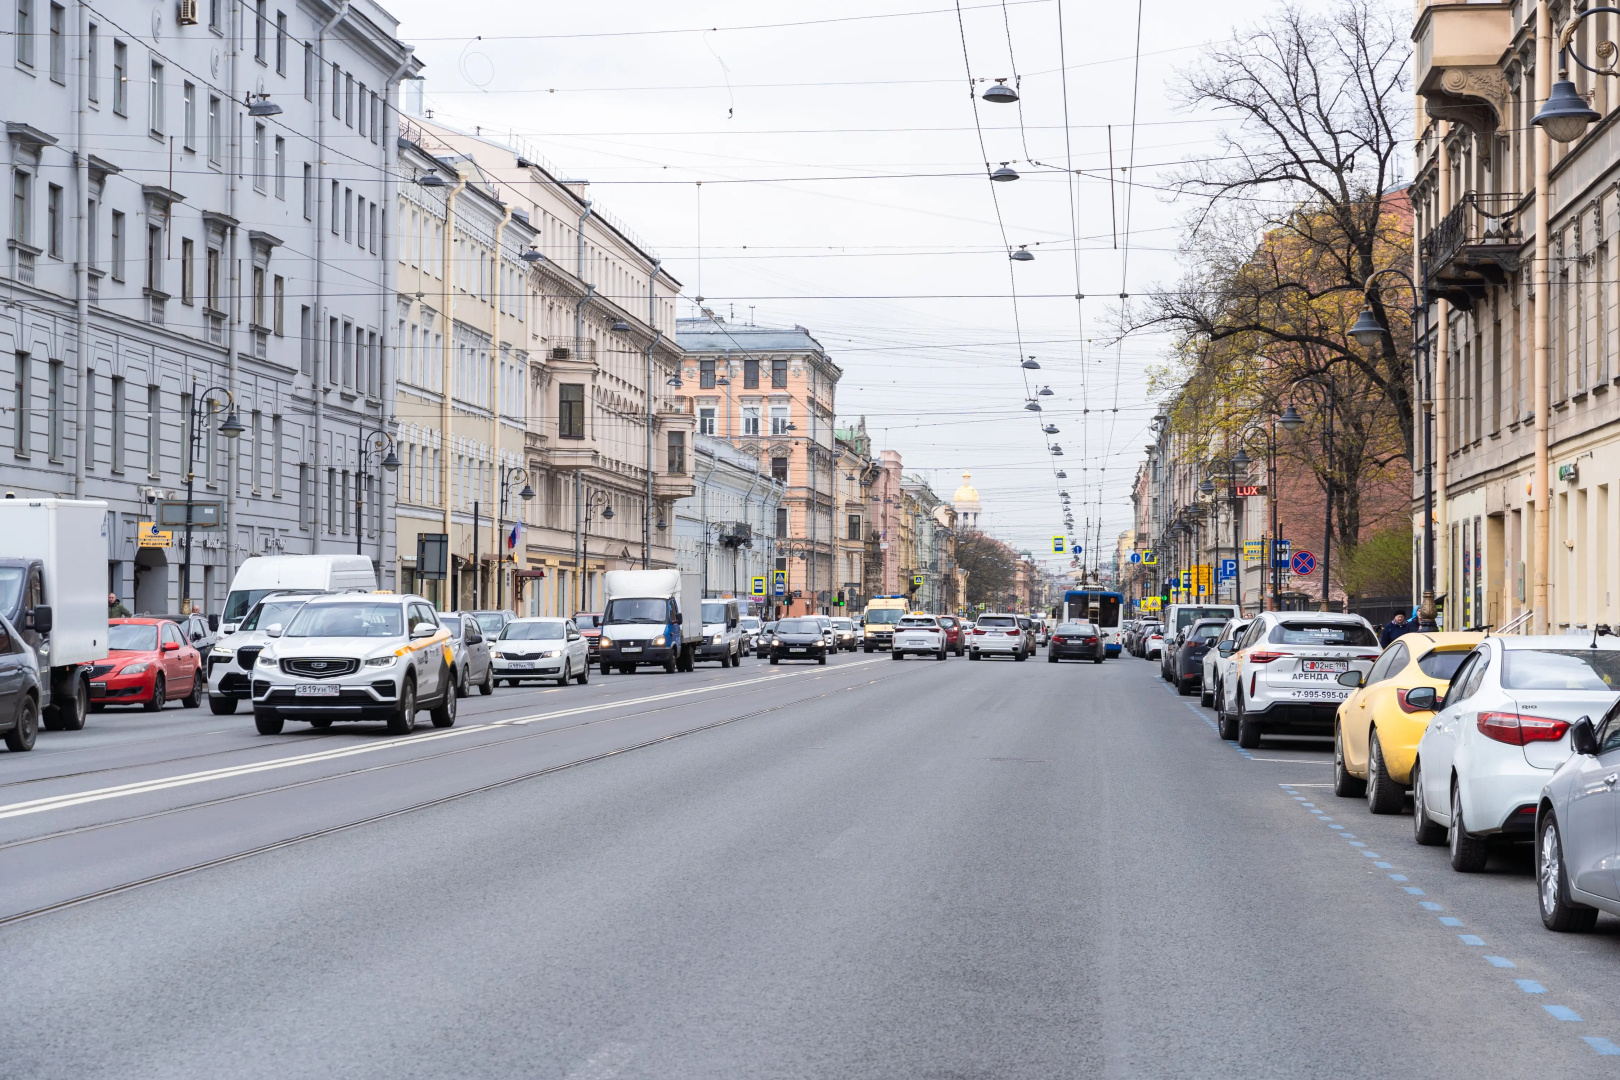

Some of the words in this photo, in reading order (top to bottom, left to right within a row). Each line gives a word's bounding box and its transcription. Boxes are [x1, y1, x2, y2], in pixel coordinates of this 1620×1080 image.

[1237, 486, 1258, 496] LUX
[1226, 561, 1236, 575] P
[1292, 673, 1329, 681] АРЕНДА
